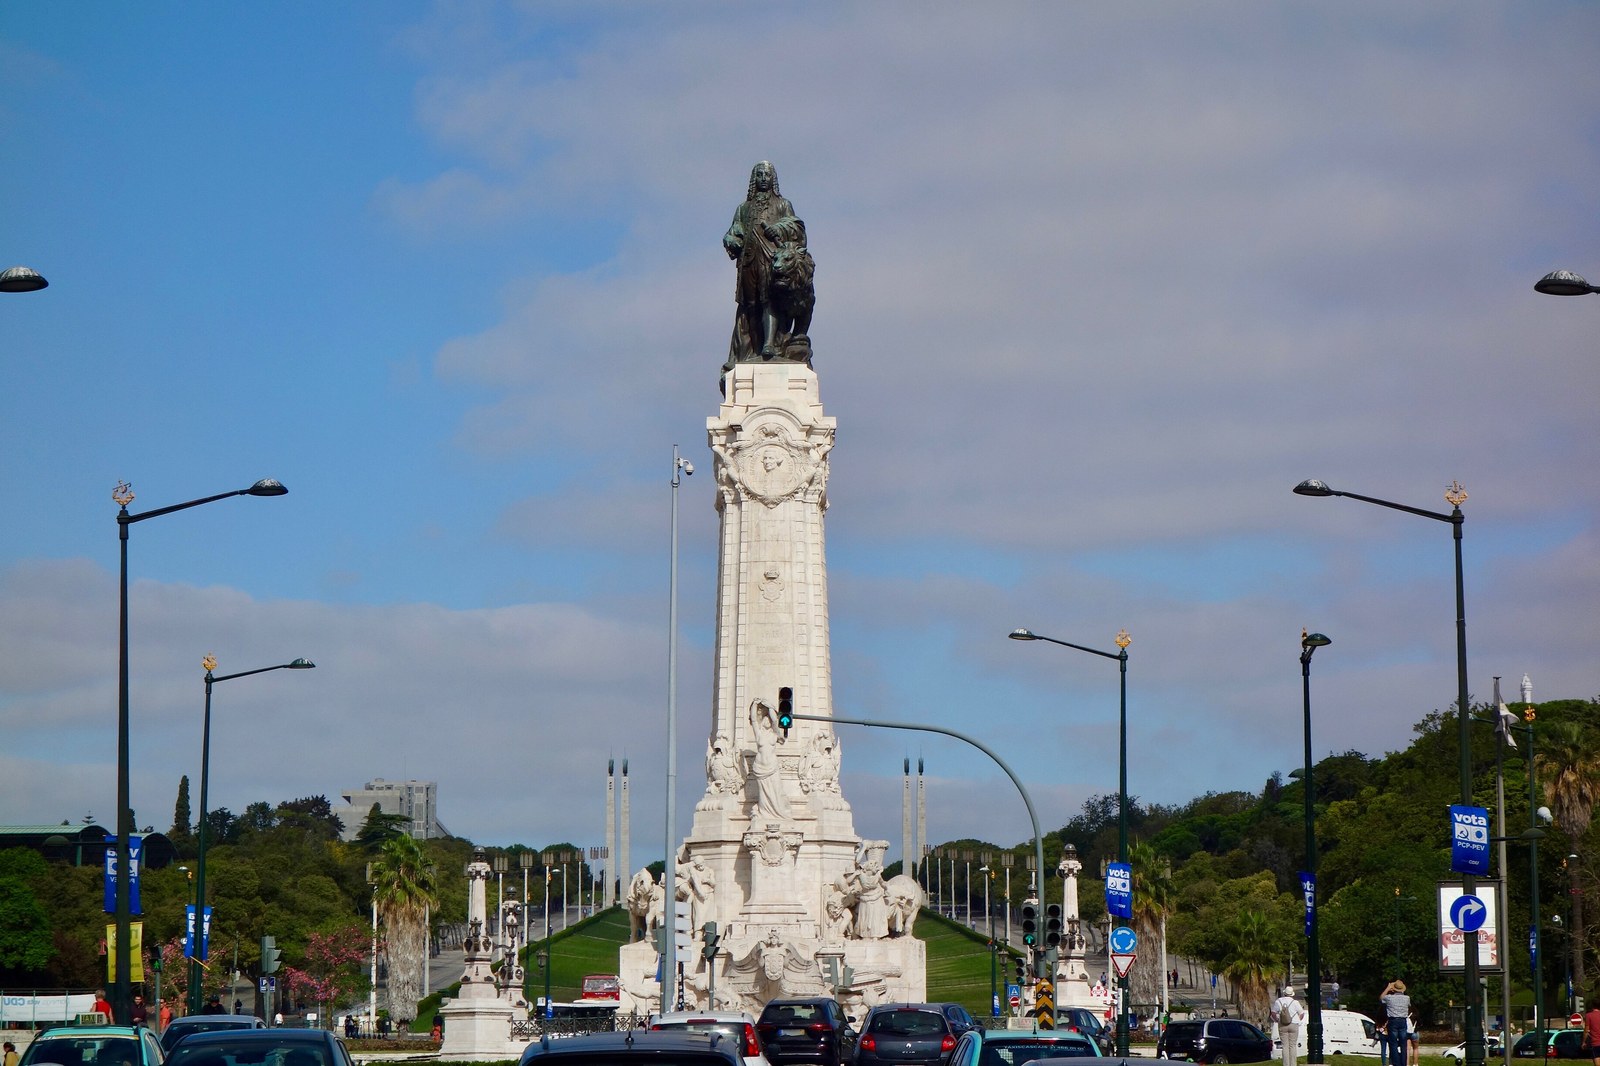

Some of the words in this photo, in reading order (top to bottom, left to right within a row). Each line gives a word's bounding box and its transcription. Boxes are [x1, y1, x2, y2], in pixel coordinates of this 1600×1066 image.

[1454, 813, 1486, 826] vota
[1458, 841, 1485, 851] PCP-PEV
[1109, 868, 1130, 878] vota
